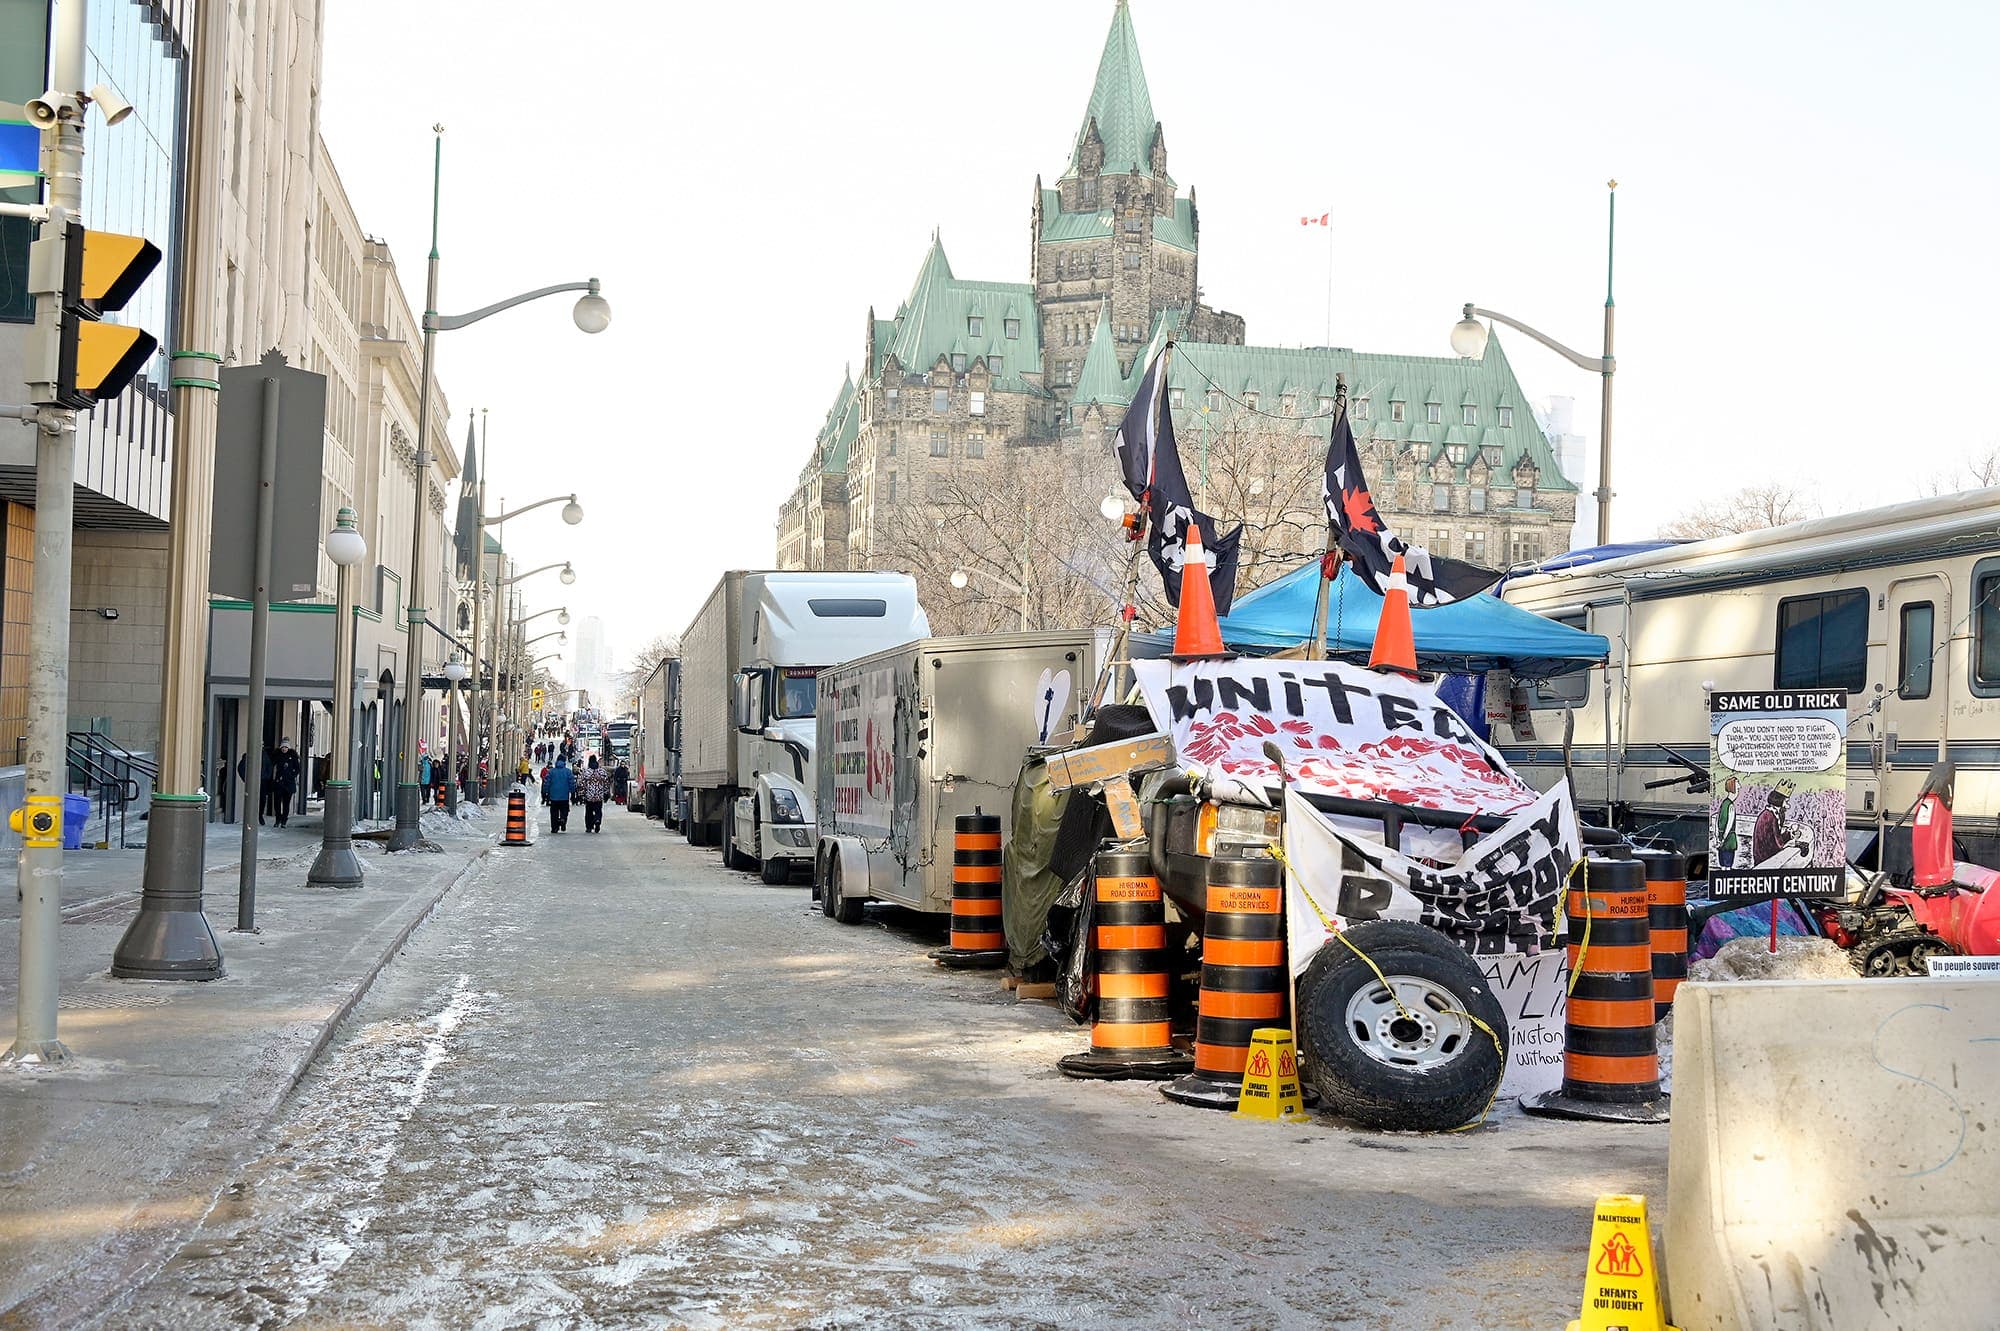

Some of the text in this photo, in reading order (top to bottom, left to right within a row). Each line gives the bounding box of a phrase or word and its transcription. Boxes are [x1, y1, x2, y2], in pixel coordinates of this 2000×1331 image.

[1719, 694, 1840, 710] SAME OLD TRICK
[1743, 725, 1756, 733] YOU
[1757, 725, 1776, 733] DON'T
[1777, 725, 1795, 733] NEED
[1796, 725, 1805, 733] TO
[1806, 724, 1826, 732] FIGHT
[1798, 733, 1806, 741] TO
[1807, 733, 1837, 741] CONVINCE
[1777, 742, 1800, 750] PEOPLE
[1819, 741, 1832, 749] THE
[1755, 750, 1779, 758] PEOPLE
[1780, 750, 1799, 758] WANT
[1811, 749, 1829, 757] TAKE
[1119, 881, 1149, 889] HURDMAN
[1715, 875, 1838, 895] DIFFERENT CENTURY
[1110, 890, 1127, 898] ROAD
[1229, 892, 1261, 900] HURDMAN
[1220, 901, 1270, 909] ROAD SERVICES
[1610, 905, 1629, 914] ROAD
[1932, 961, 2000, 972] Un peuple souver
[1600, 1287, 1638, 1299] ENFANTS
[1594, 1299, 1644, 1312] QUI JOUENT
